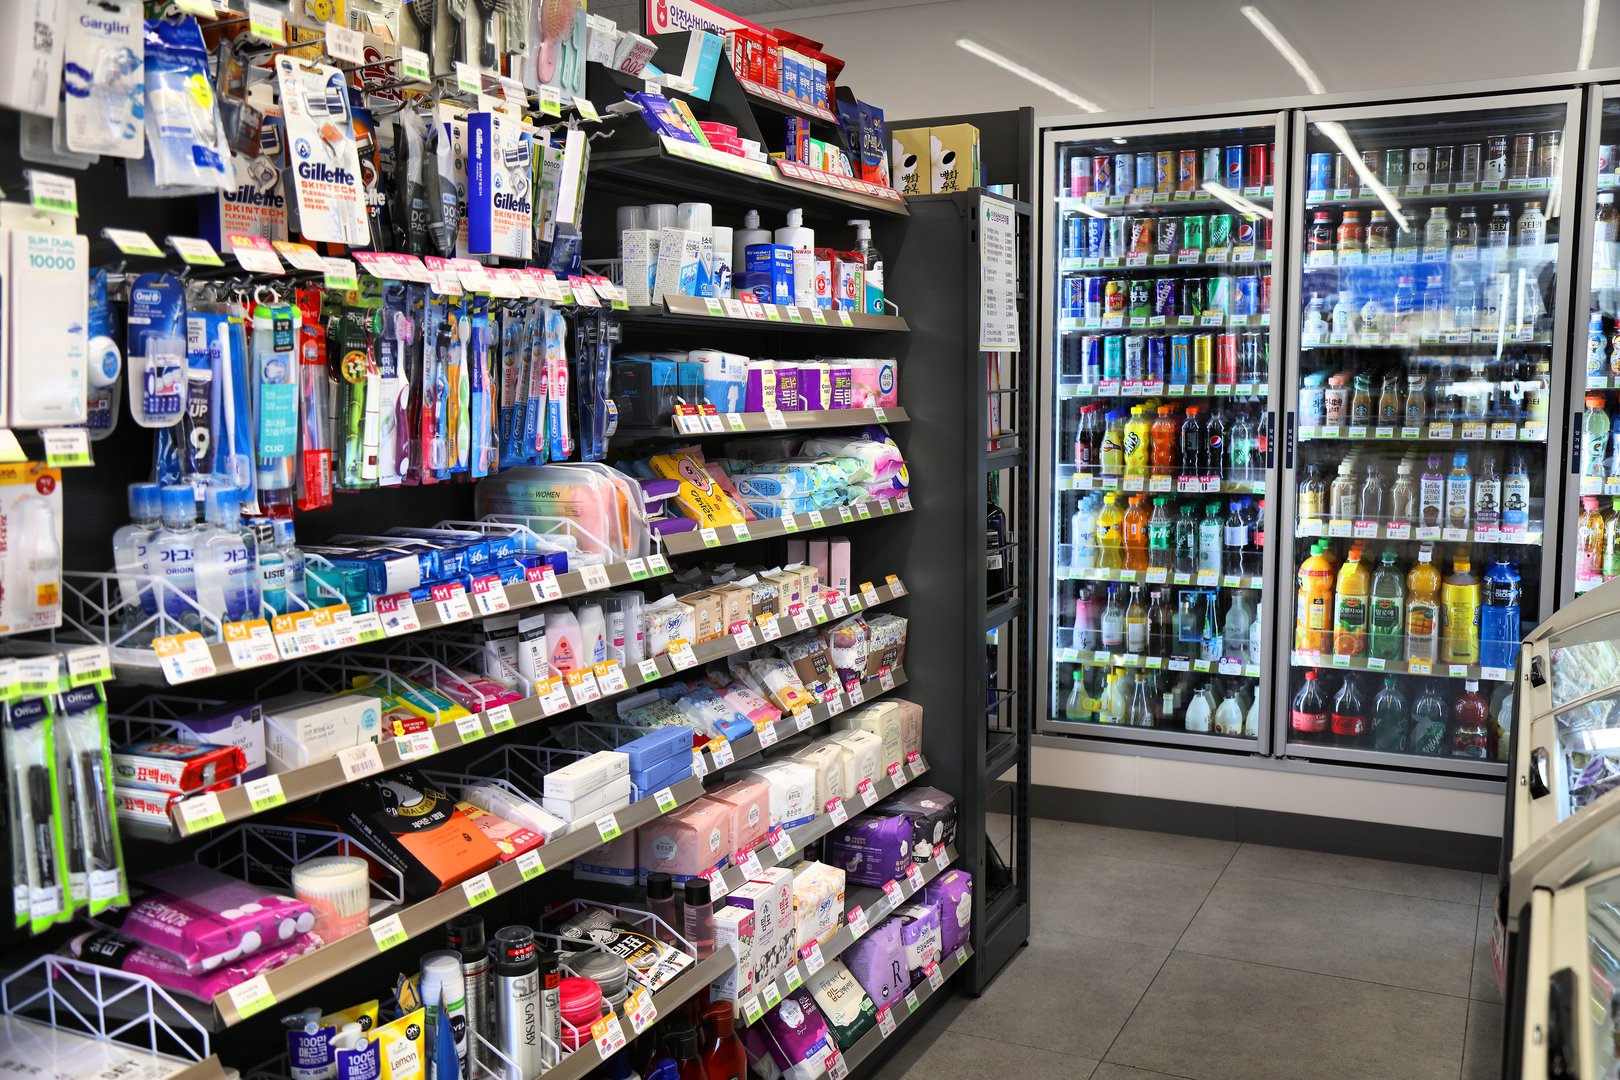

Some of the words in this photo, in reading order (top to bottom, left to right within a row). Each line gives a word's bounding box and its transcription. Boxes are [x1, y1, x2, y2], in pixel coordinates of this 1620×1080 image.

[80, 14, 130, 35] Garglin
[620, 57, 645, 76] 0.02
[298, 161, 355, 186] Gillette
[301, 180, 356, 195] SKINTECH
[223, 185, 285, 209] Gillette
[493, 192, 531, 215] Gillette
[224, 203, 285, 218] SKINTECH
[494, 209, 531, 222] SKINTECH
[27, 235, 48, 247] SLIM
[51, 237, 76, 249] DUAL
[29, 254, 76, 271] 10000
[188, 336, 199, 344] KIT
[189, 404, 208, 418] UP
[190, 426, 210, 460] 9
[264, 444, 285, 453] CLIO
[535, 489, 561, 499] WOMEN
[1150, 528, 1171, 540] prite
[165, 567, 195, 575] ORIGIN
[456, 556, 464, 572] 7
[528, 569, 542, 581] 1+1
[433, 587, 450, 599] 1+1
[473, 580, 488, 593] 1+1
[379, 598, 396, 612] 1+1
[275, 616, 293, 630] 2+1
[313, 610, 331, 622] 2+1
[226, 624, 247, 638] 2+1
[156, 638, 180, 652] 2+1
[595, 663, 606, 674] 2+1
[569, 673, 581, 685] 2+1
[538, 681, 550, 692] 2+1
[401, 800, 434, 816] MALPYO
[768, 833, 779, 844] 1+1
[736, 852, 748, 862] 1+1
[802, 947, 812, 957] 1+1
[891, 960, 903, 989] R
[624, 997, 637, 1011] 2+1
[524, 1002, 536, 1047] GATSBY
[592, 1024, 606, 1035] 2+1
[299, 1035, 327, 1048] 100만
[348, 1048, 375, 1064] 100만
[390, 1051, 417, 1071] Lemon
[825, 1057, 835, 1068] 1+1
